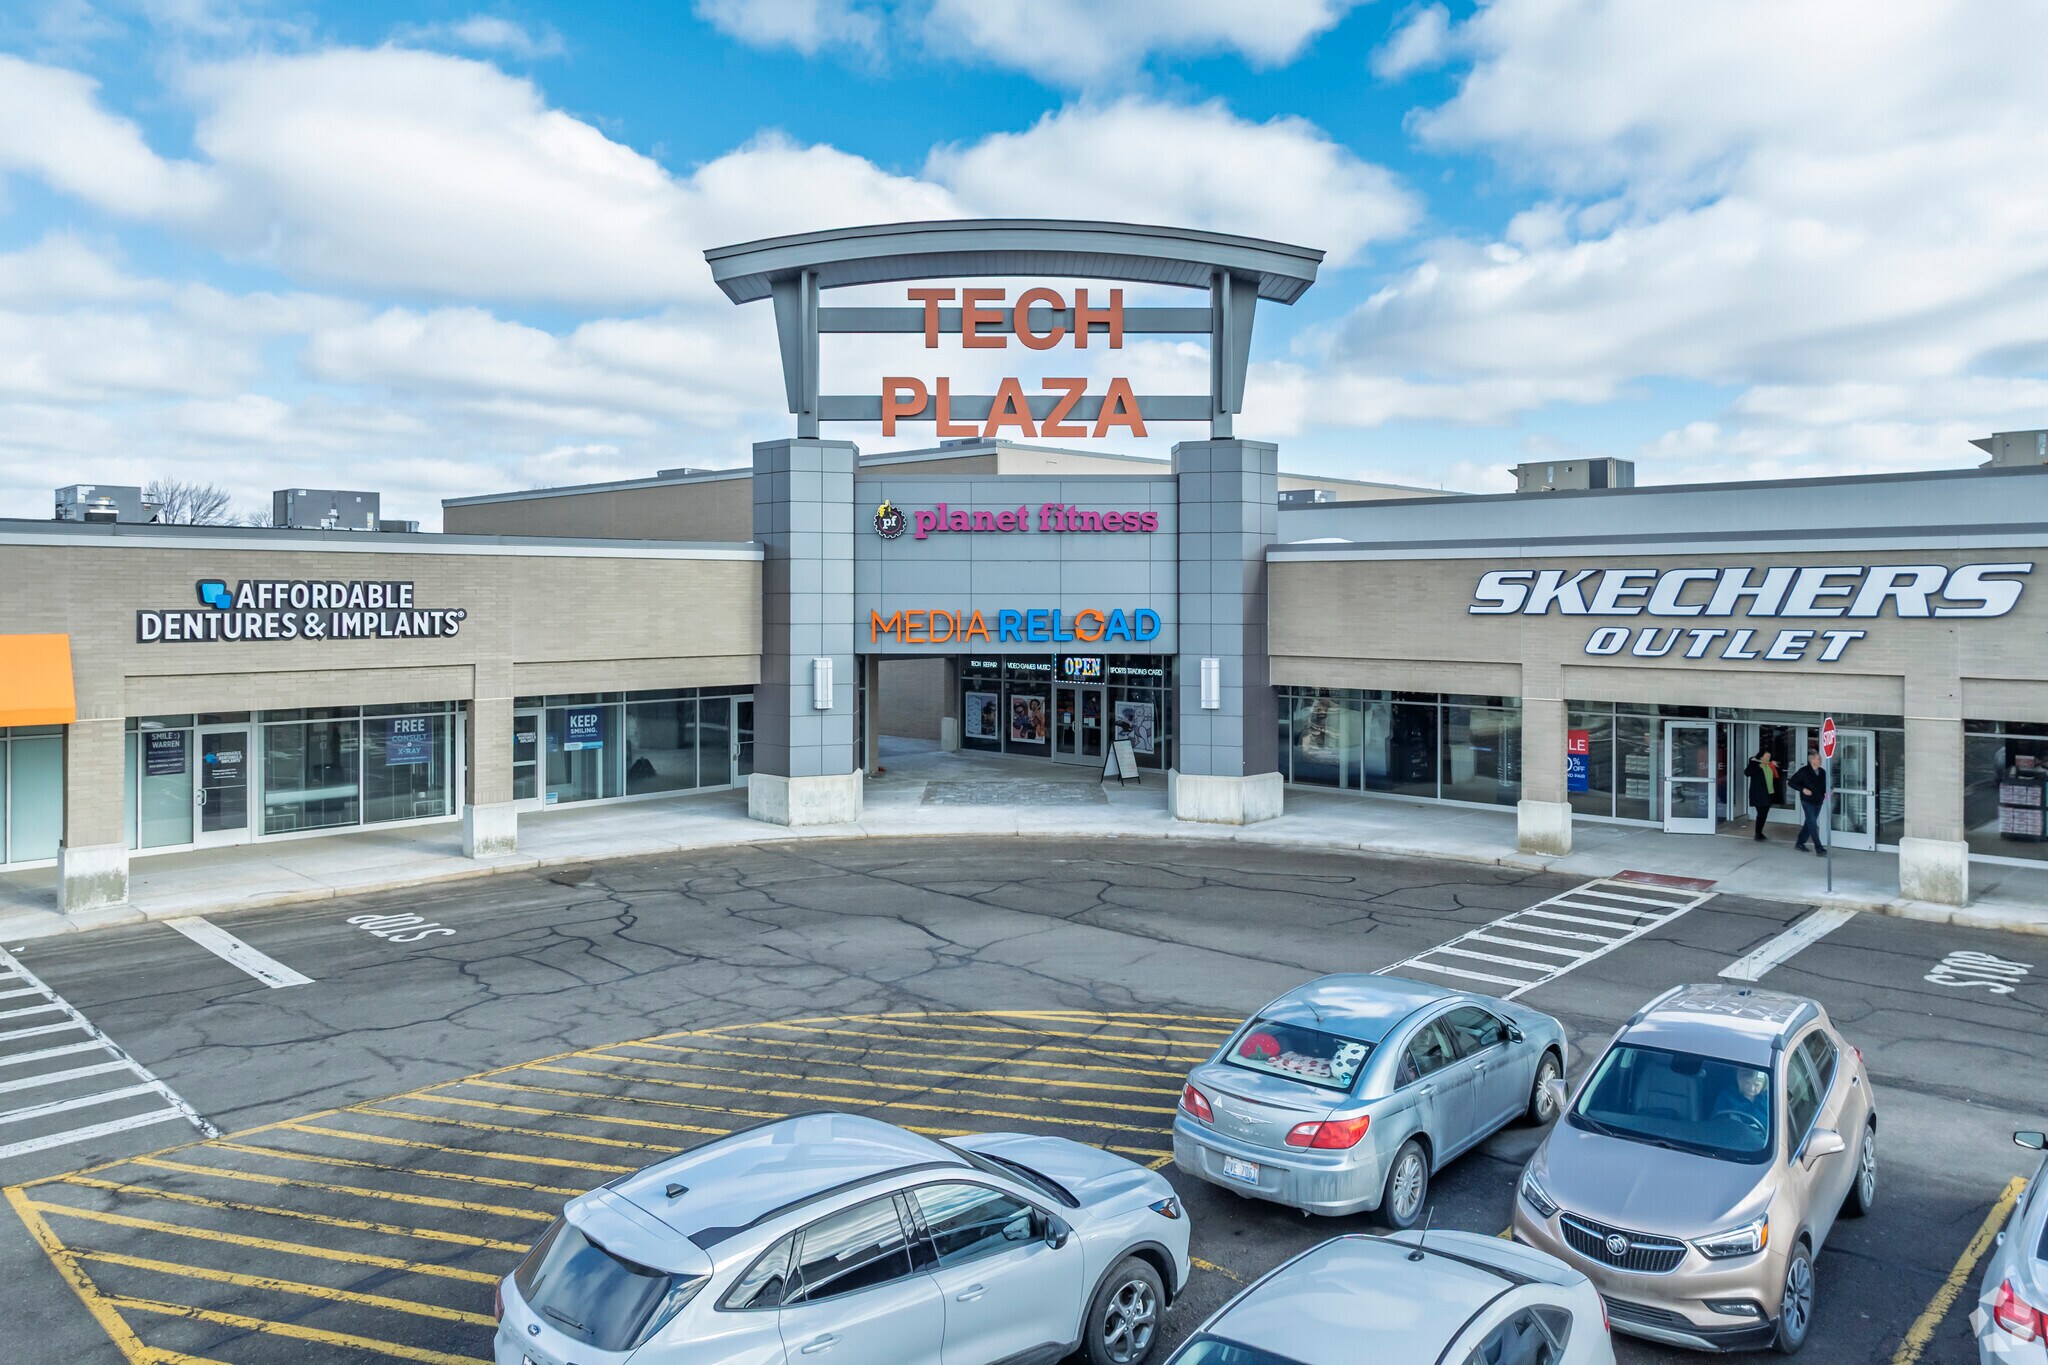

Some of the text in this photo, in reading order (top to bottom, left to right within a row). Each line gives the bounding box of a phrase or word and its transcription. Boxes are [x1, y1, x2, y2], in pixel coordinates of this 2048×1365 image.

[907, 287, 1123, 350] TECH
[882, 377, 1148, 437] PLAZA
[882, 515, 898, 530] pf
[913, 502, 1159, 539] planet fitness
[235, 583, 413, 609] AFFORDABLE
[1468, 561, 2035, 618] SKECHERS
[141, 612, 298, 640] DENTURES
[304, 613, 327, 638] &
[871, 608, 1161, 643] MEDIA RELOAD
[1584, 626, 1867, 662] OUTLET
[1064, 657, 1101, 676] OPEN
[394, 719, 425, 733] FREE
[570, 714, 598, 728] KEEP
[151, 732, 172, 741] SMILE
[151, 740, 180, 749] WARREN
[391, 733, 427, 742] CONSULT
[1823, 730, 1835, 747] STOP
[346, 912, 456, 942] STOP
[1923, 950, 2034, 994] STOP
